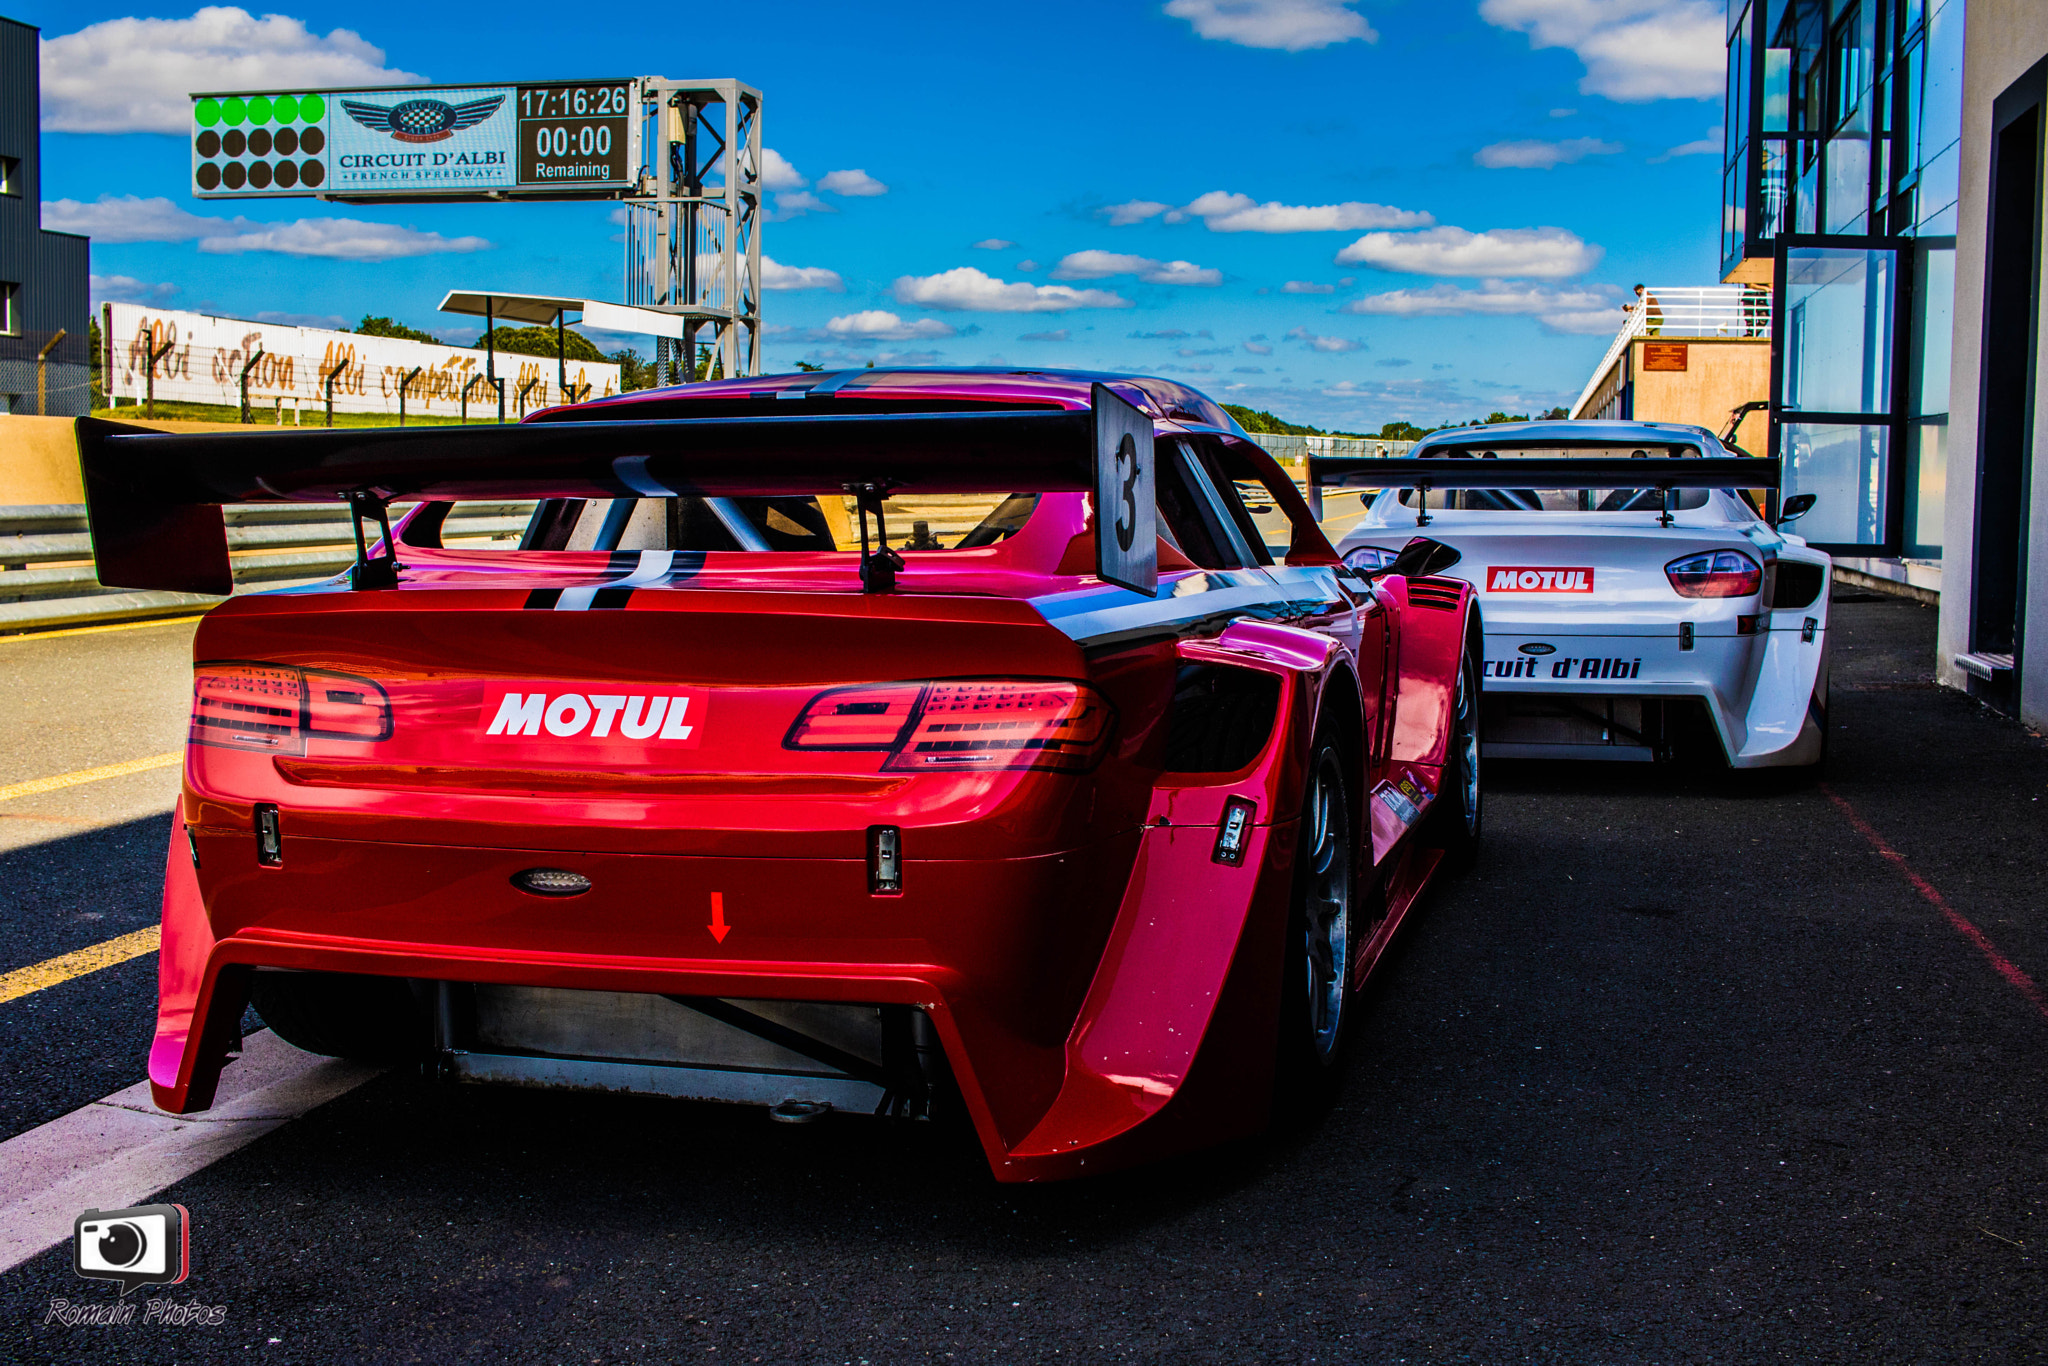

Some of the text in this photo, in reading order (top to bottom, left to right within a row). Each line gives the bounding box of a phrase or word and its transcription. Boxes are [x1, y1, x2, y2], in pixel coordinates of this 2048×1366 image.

[398, 102, 447, 114] CIRCUIT
[521, 87, 626, 117] 17:16:26
[408, 125, 436, 135] ALBI
[536, 125, 612, 158] 00:00
[339, 151, 506, 169] CIRCUIT D'ALBI
[536, 161, 610, 180] Remaining
[352, 169, 493, 180] FRENCH SPEEDWAY
[125, 316, 194, 386] Albi
[212, 332, 296, 391] action
[315, 340, 367, 402] Albi
[512, 361, 550, 413] Albi
[1115, 432, 1138, 553] 3
[1491, 570, 1589, 590] MOTUL
[1483, 657, 1642, 679] cuit d'Albi
[486, 692, 694, 740] MOTUL
